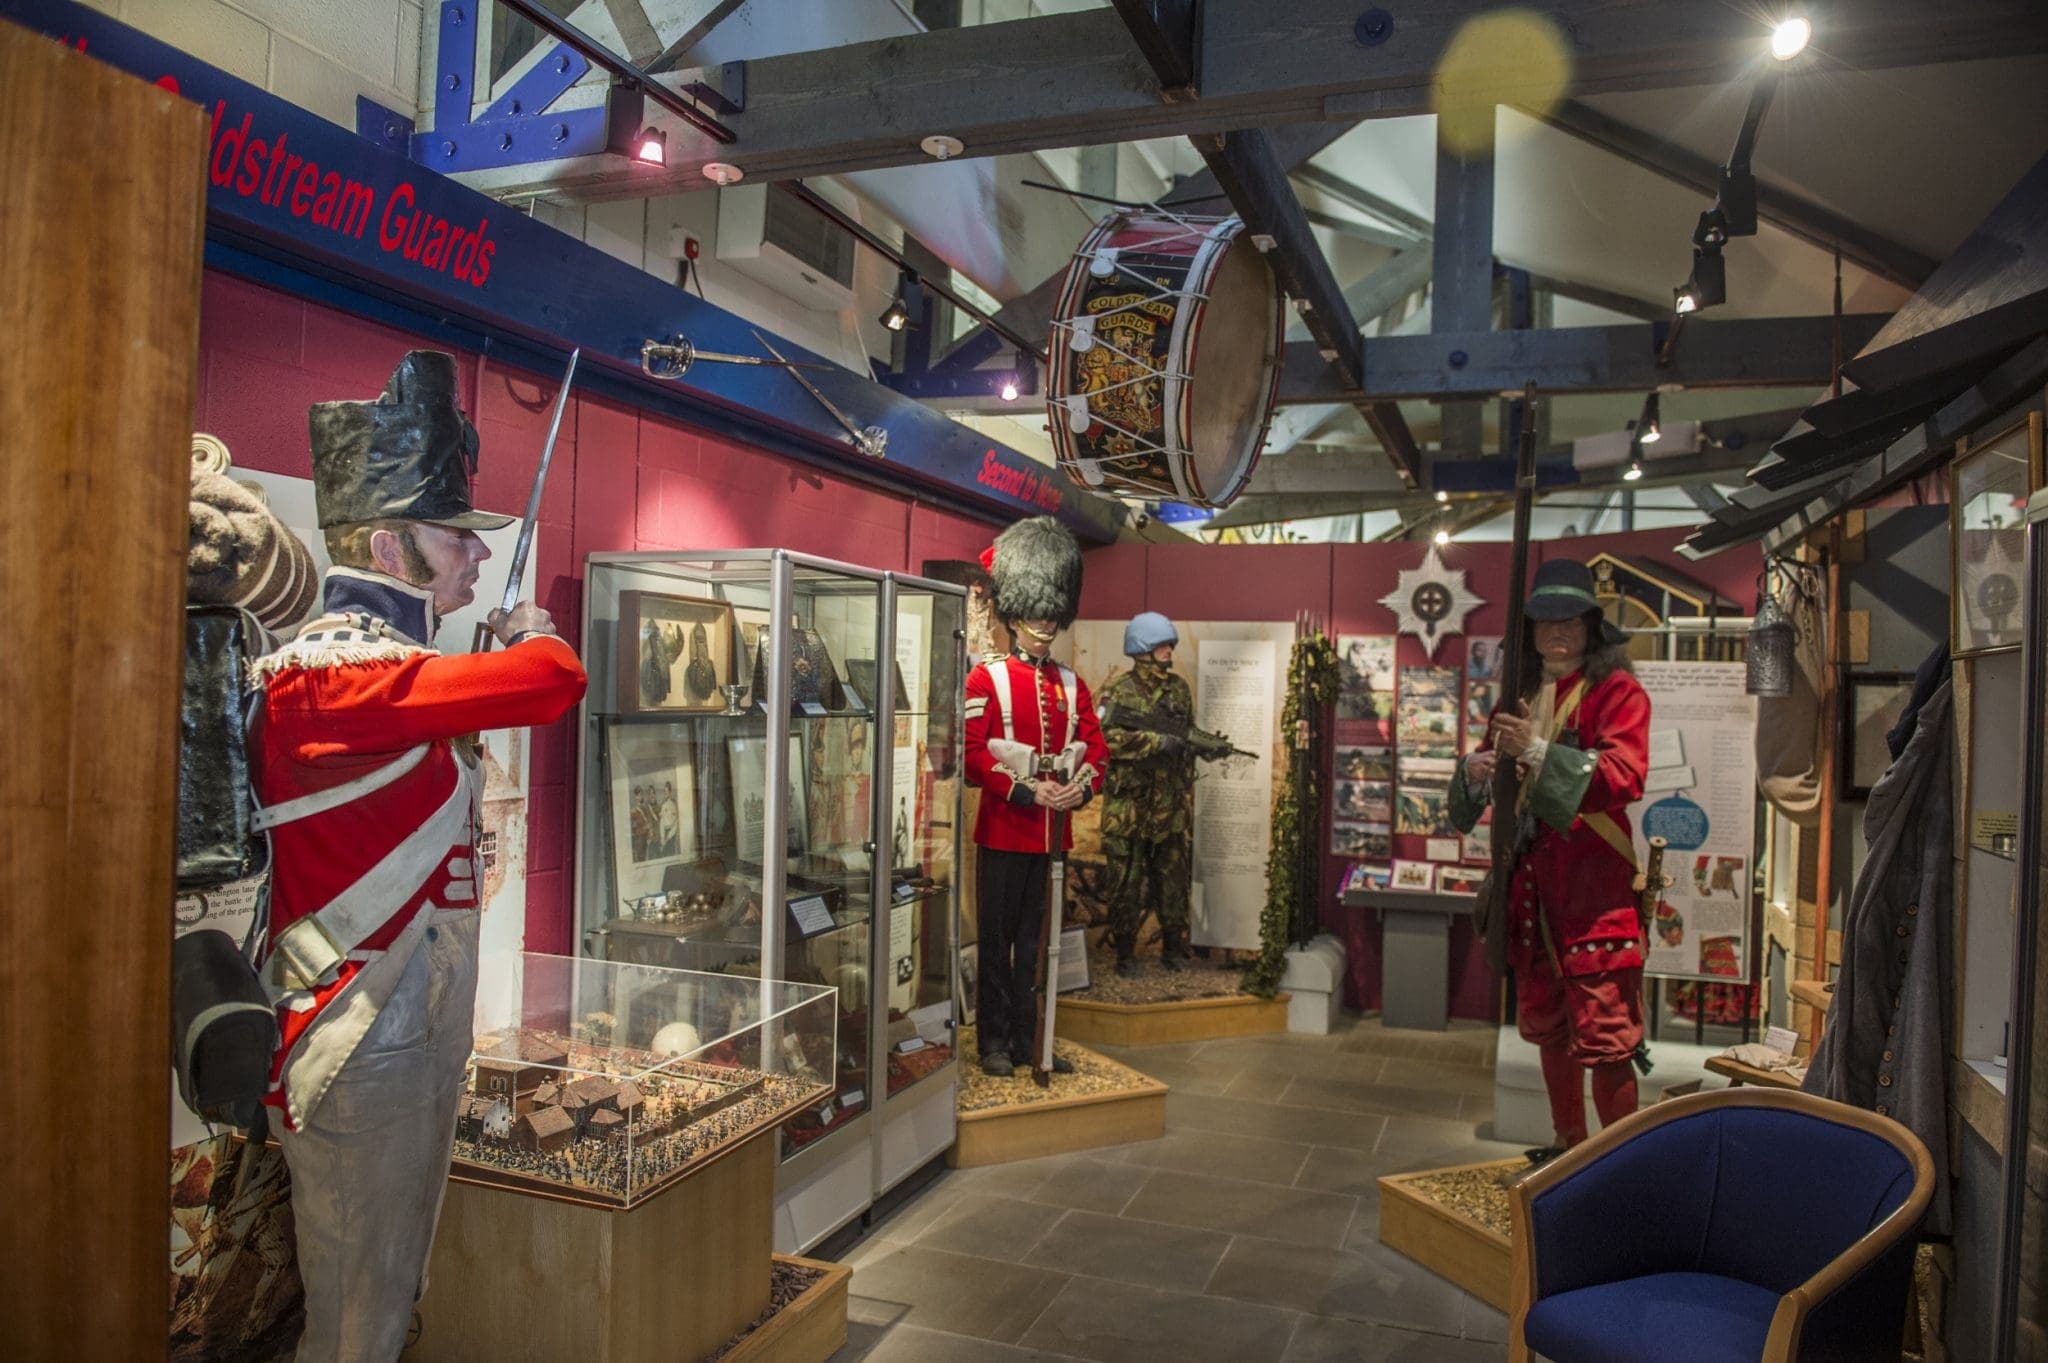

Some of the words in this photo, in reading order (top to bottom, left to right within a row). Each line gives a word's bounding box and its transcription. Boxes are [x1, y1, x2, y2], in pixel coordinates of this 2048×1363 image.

[158, 76, 374, 240] ldstream
[378, 181, 497, 288] Guards
[1101, 314, 1151, 331] GUARDS
